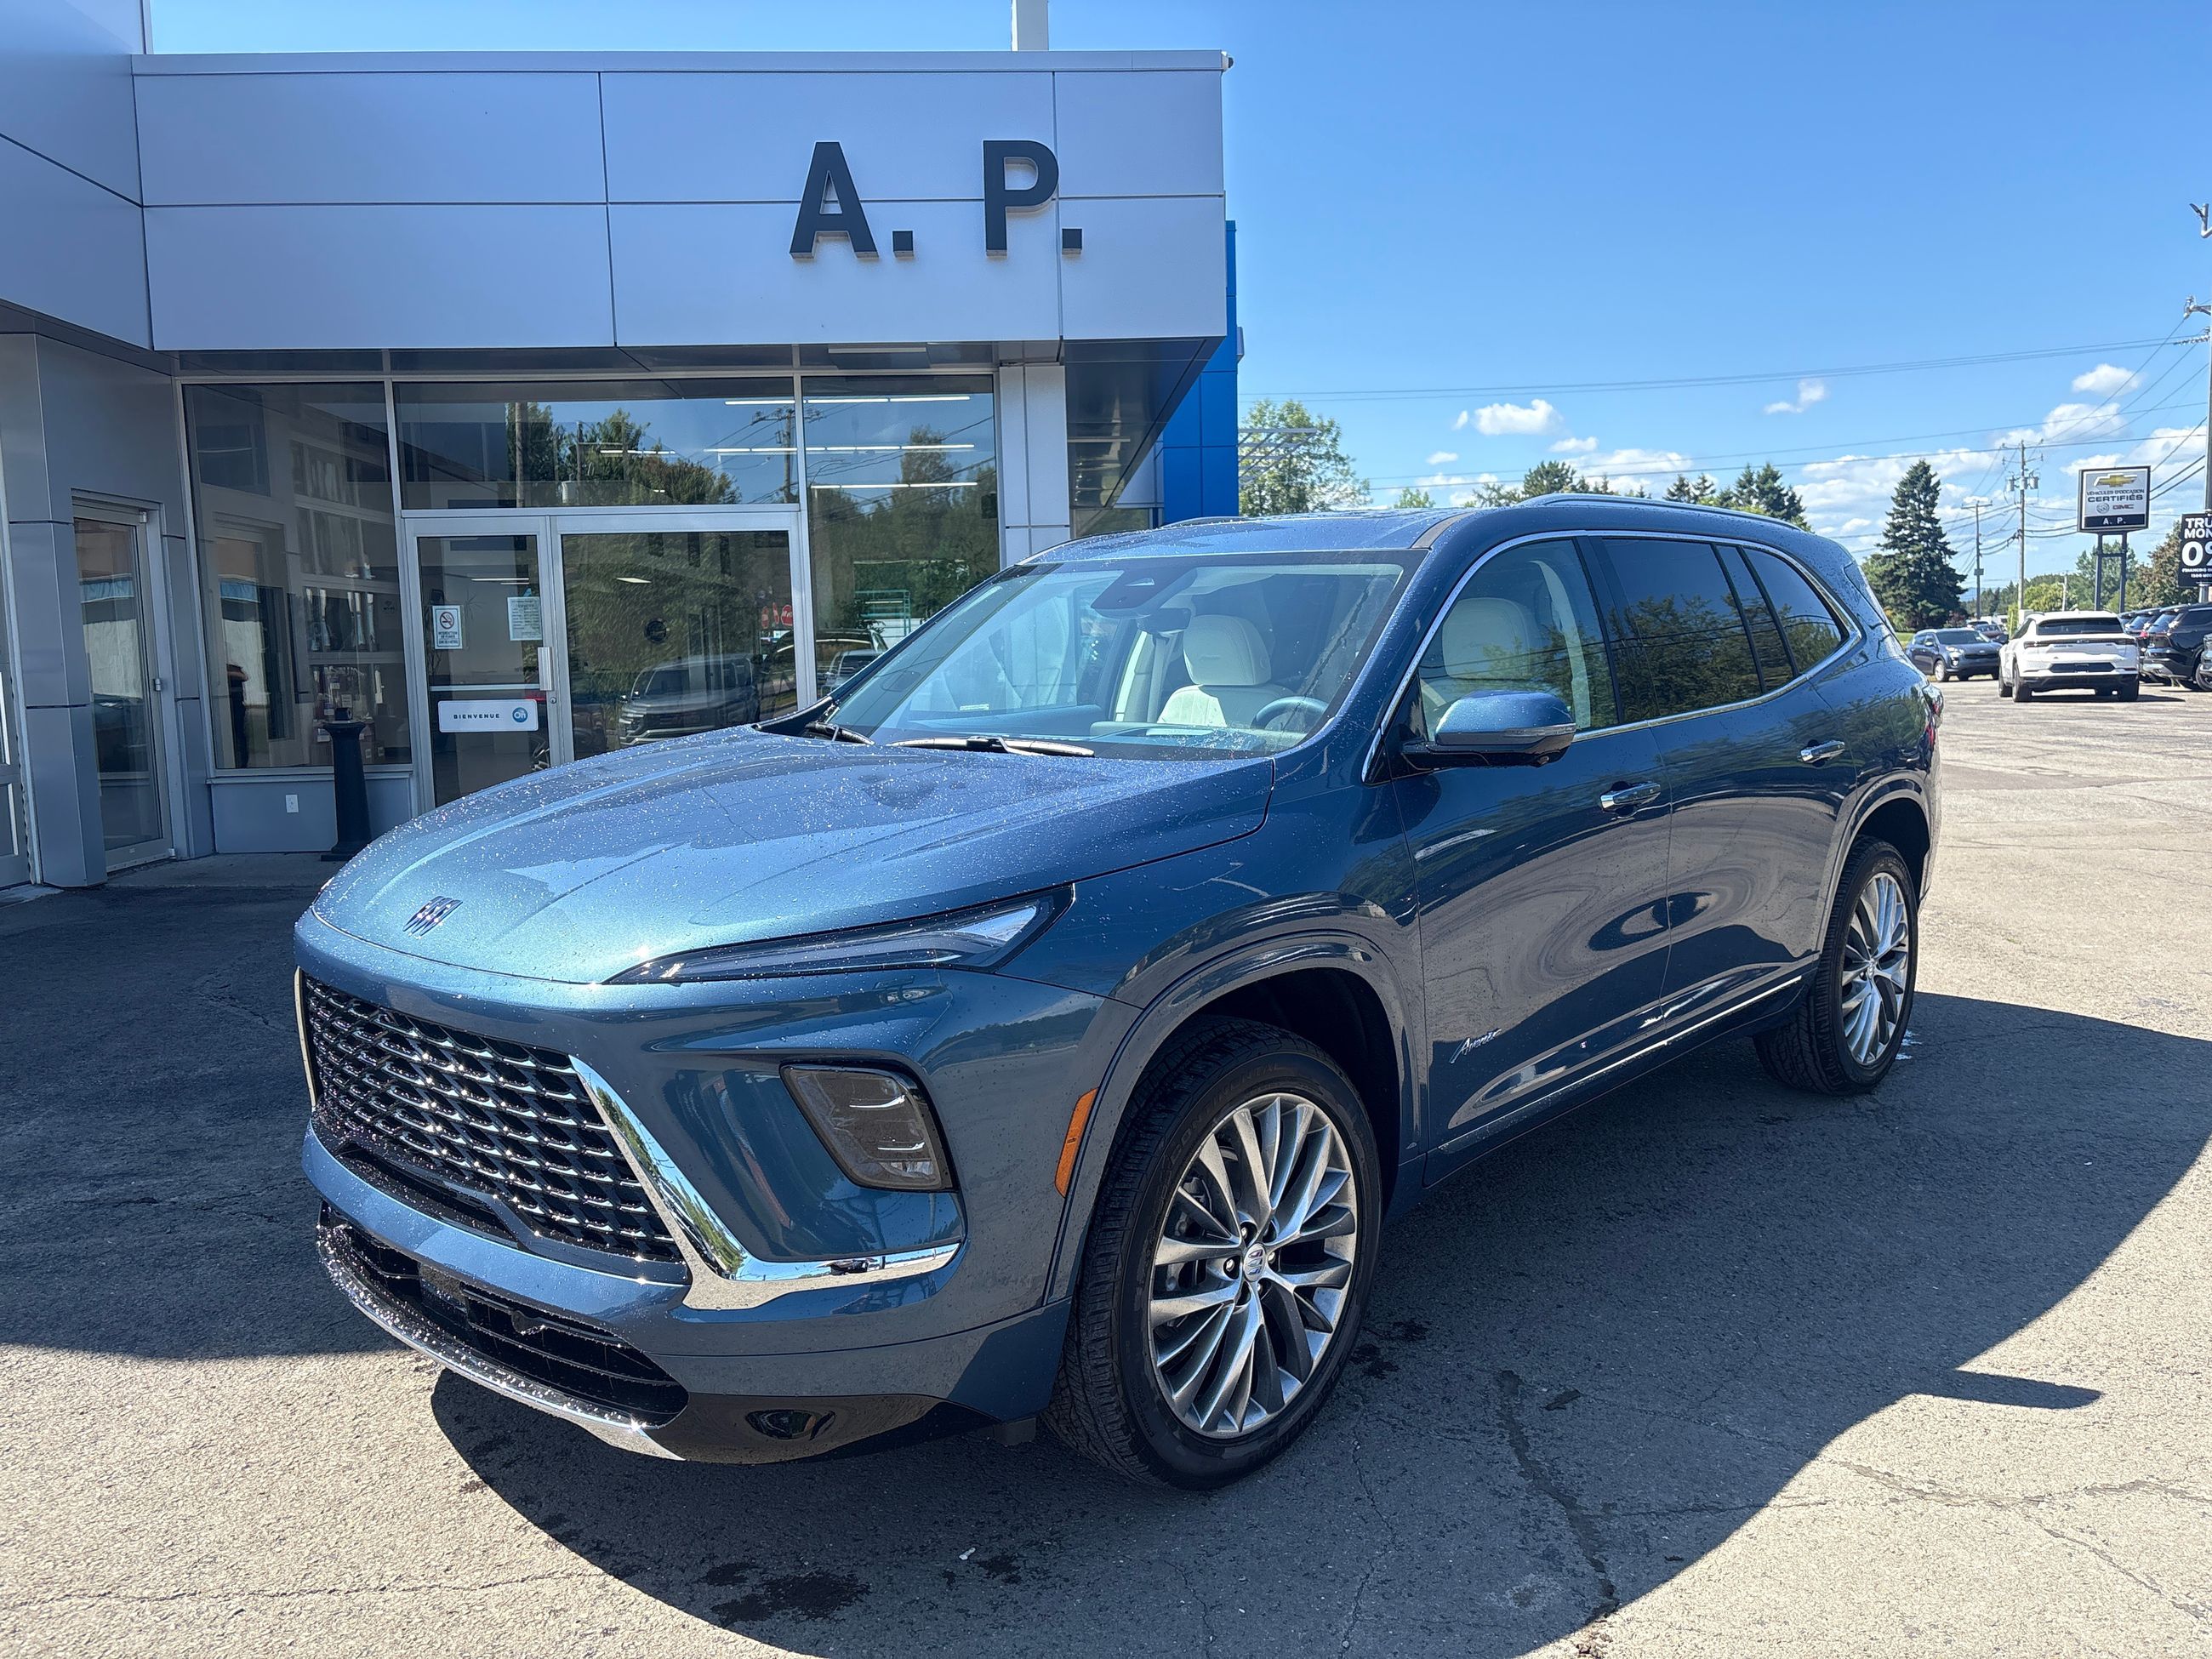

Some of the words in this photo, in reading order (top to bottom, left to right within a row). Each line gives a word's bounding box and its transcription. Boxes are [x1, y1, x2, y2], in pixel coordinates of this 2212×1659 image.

[790, 141, 915, 258] A.
[983, 140, 1082, 256] P.
[2088, 493, 2143, 503] CERTIFIÉS
[2102, 517, 2112, 526] A.
[2117, 516, 2127, 525] P.
